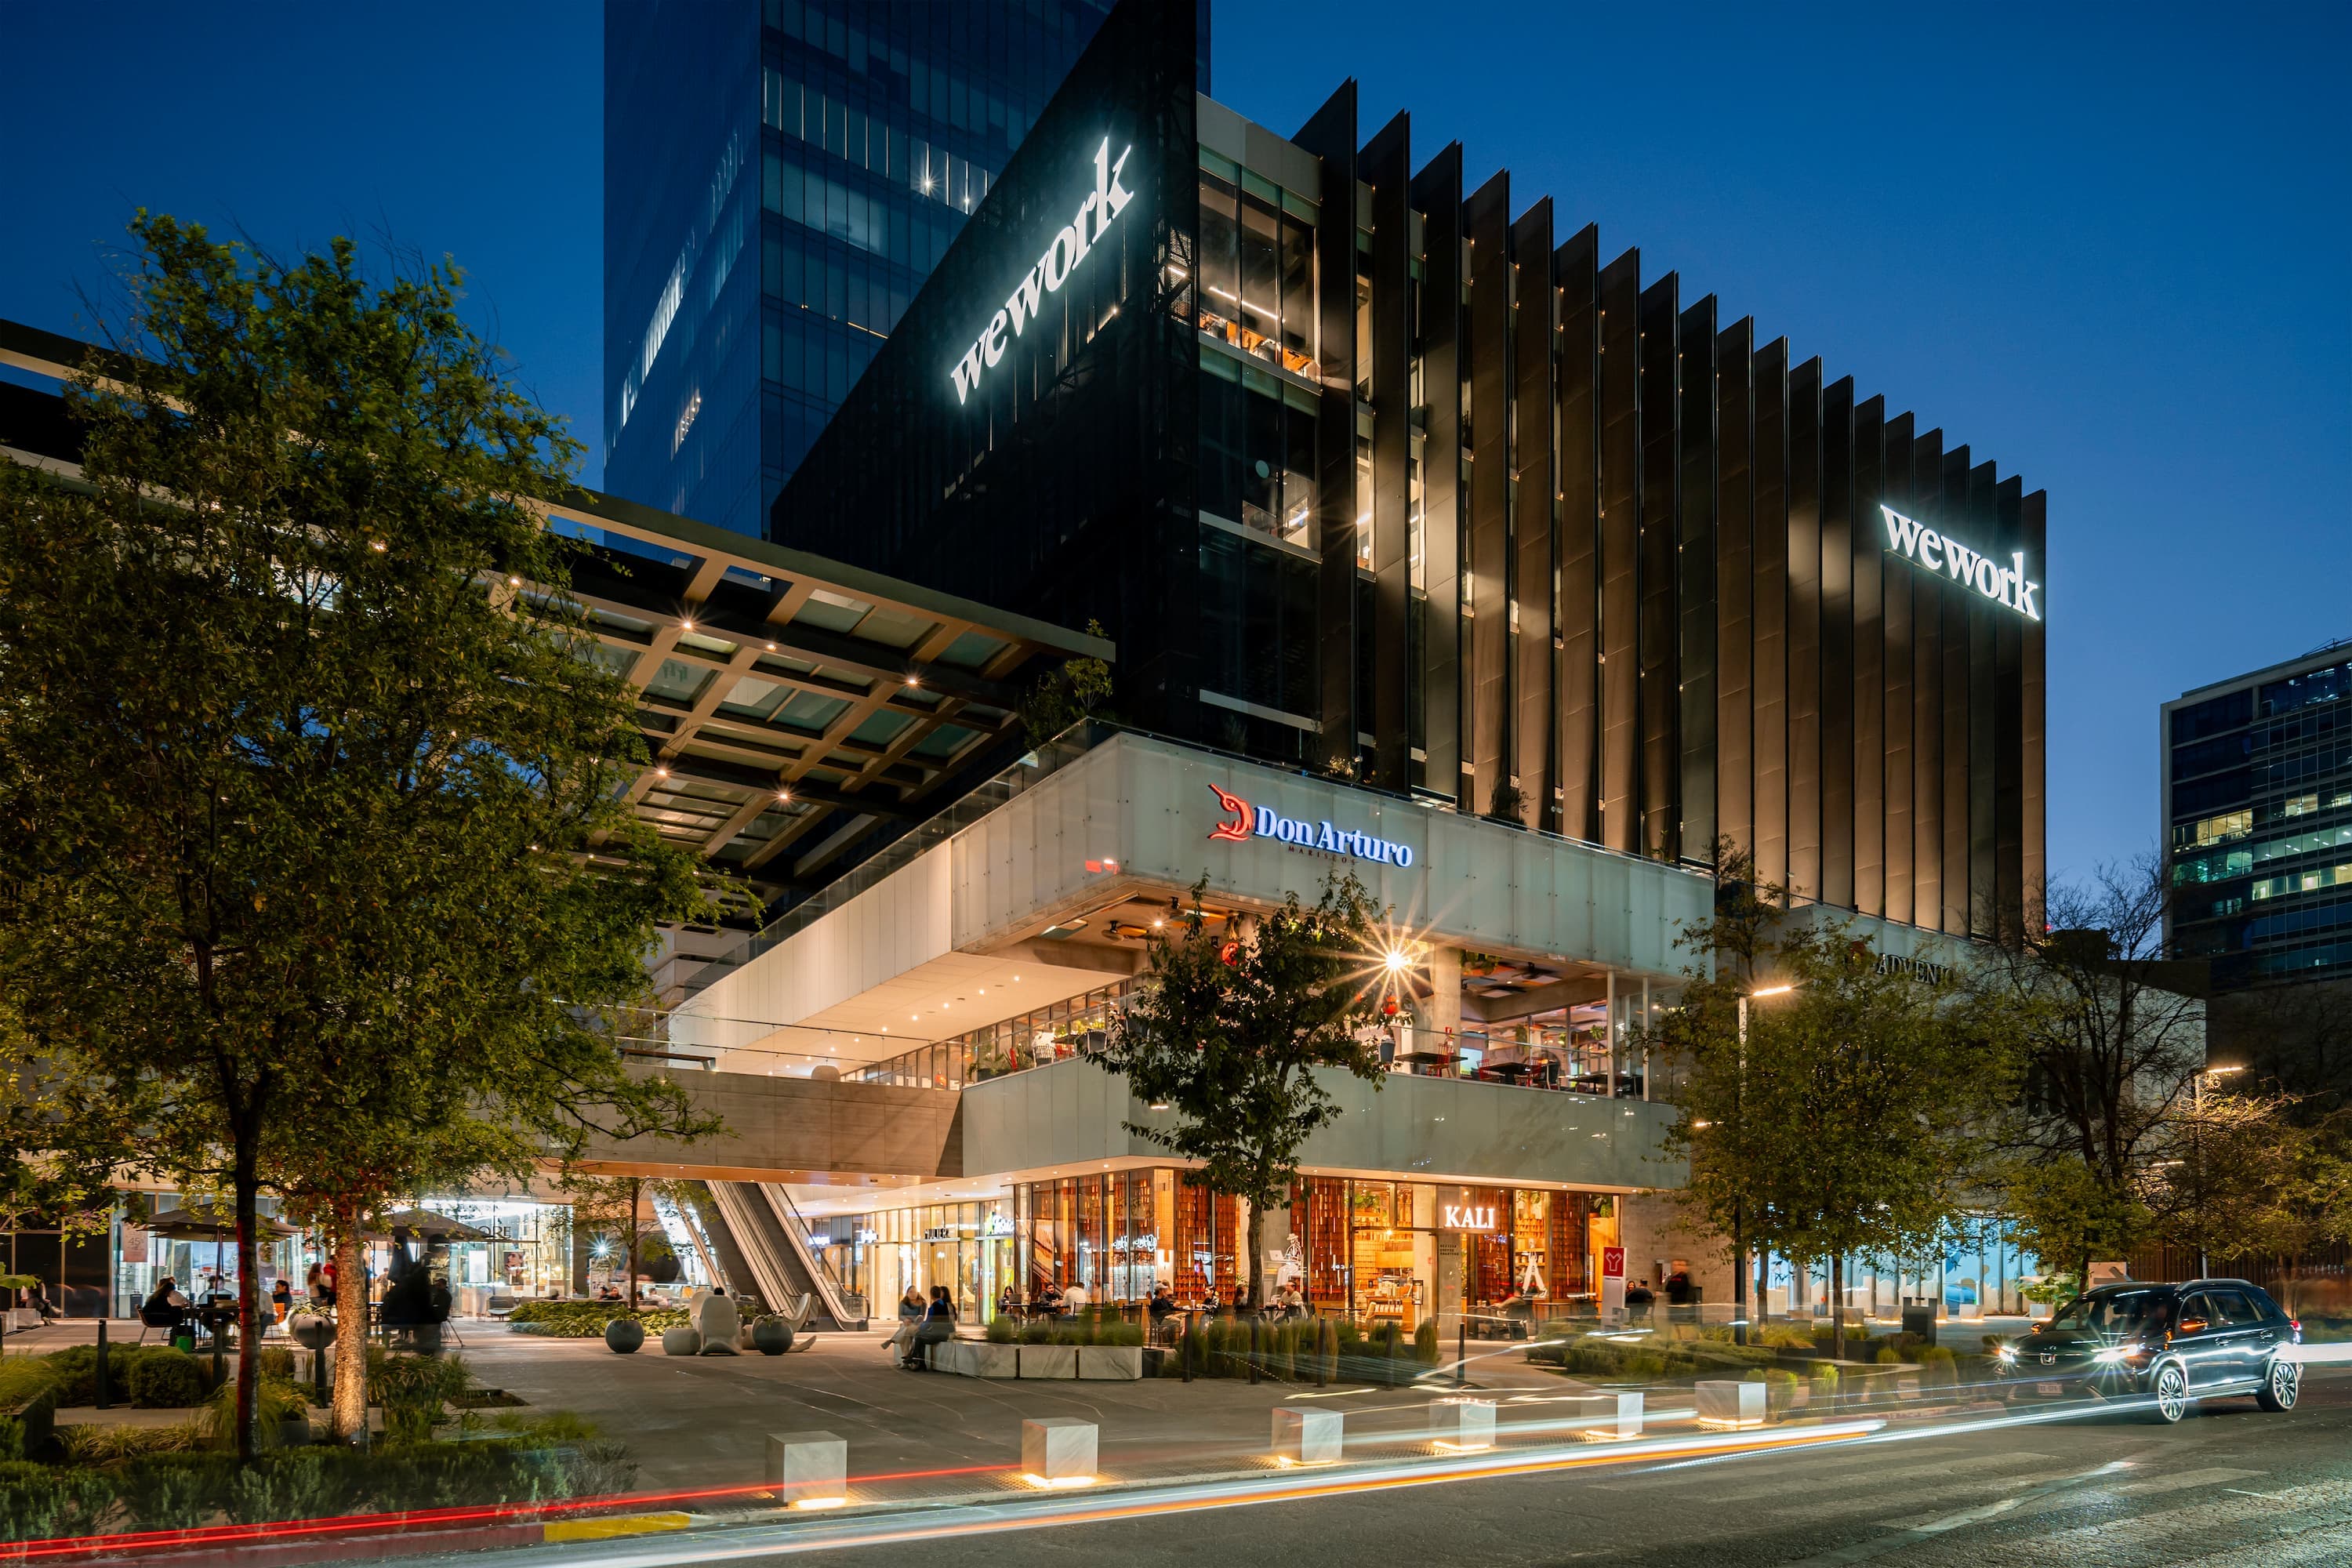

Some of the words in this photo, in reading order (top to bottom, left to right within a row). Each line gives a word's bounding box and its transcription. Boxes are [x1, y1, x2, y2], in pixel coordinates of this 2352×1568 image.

[951, 136, 1134, 406] wework
[1880, 504, 2040, 622] wework
[1254, 805, 1314, 847] Don
[1316, 820, 1413, 868] Arturo
[1288, 845, 1356, 866] MARISCOS
[1444, 1205, 1495, 1229] KALI
